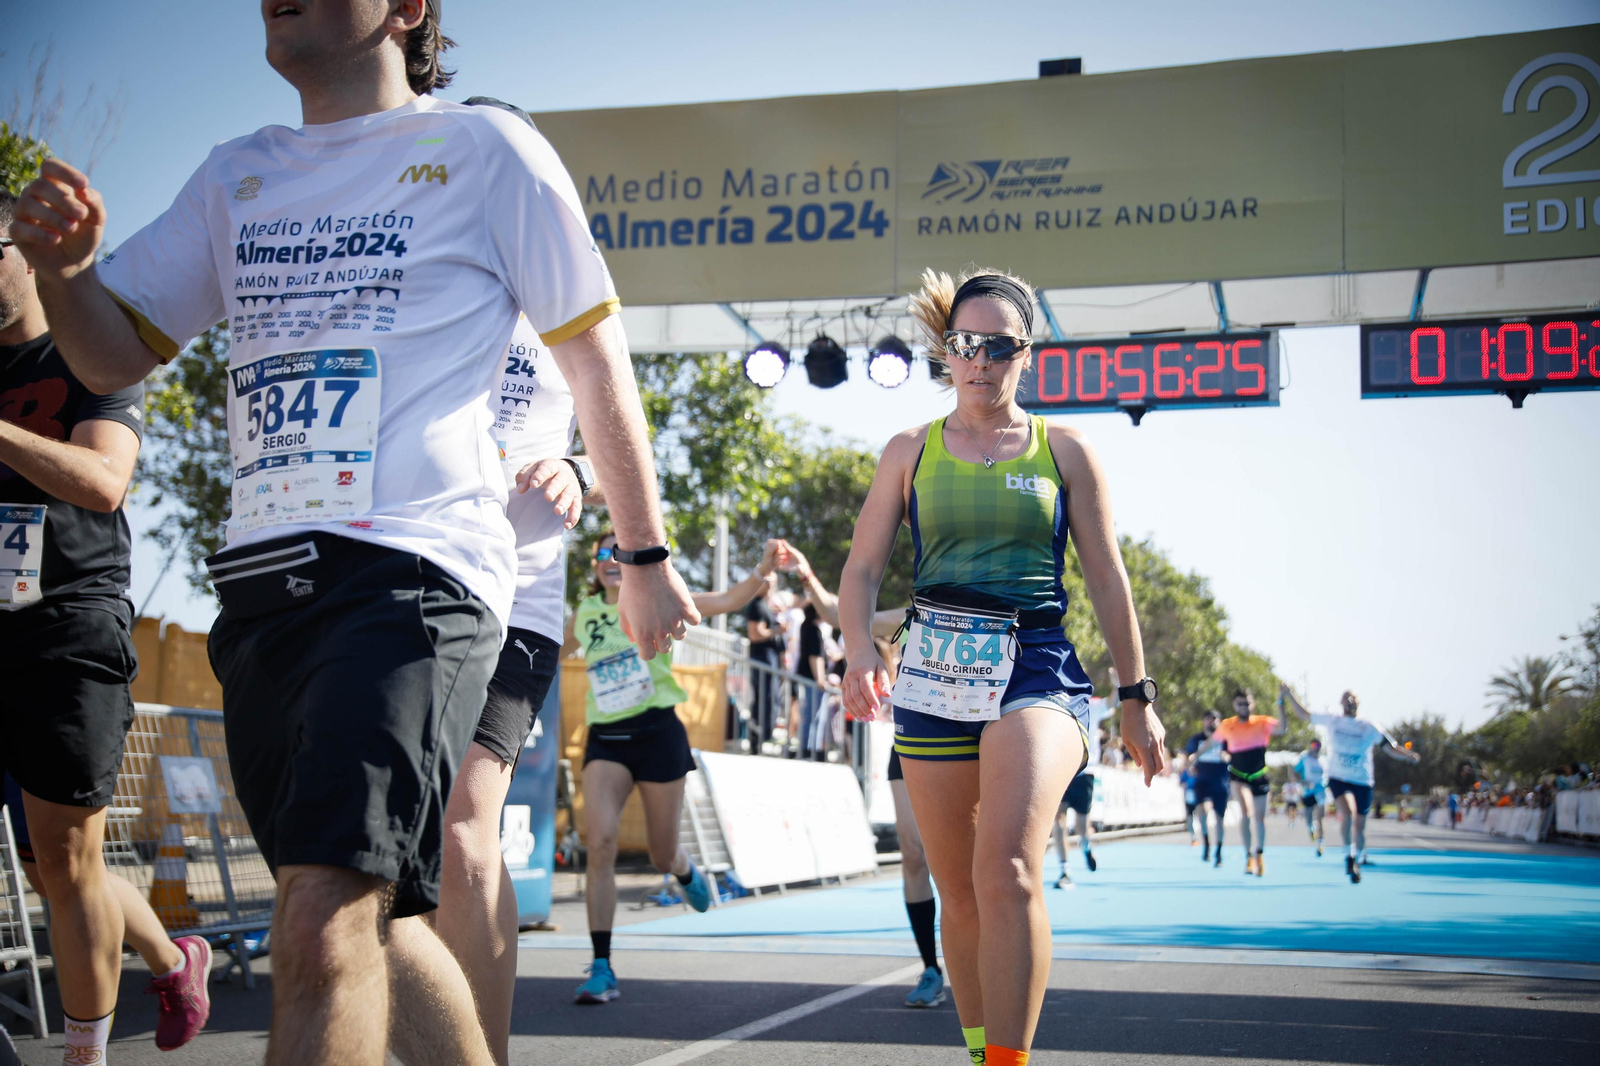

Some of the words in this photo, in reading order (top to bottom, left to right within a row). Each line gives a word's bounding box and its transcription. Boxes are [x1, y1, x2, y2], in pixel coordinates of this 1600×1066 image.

[586, 169, 703, 205] Medio
[721, 160, 890, 199] Maratón
[996, 173, 1063, 188] SERIES
[240, 217, 302, 242] Medio
[311, 209, 414, 235] Maratón
[588, 206, 754, 251] Almería
[765, 199, 890, 244] 2024
[917, 208, 1022, 237] RAMÓN
[1035, 207, 1102, 231] RUIZ
[1114, 196, 1259, 227] ANDÚJAR
[1502, 196, 1600, 236] EDI
[236, 237, 328, 268] Almería
[328, 231, 408, 258] 2024
[235, 272, 279, 290] AMÓN
[286, 272, 320, 289] RUIZ
[324, 264, 404, 284] ANDÚJAR
[329, 312, 348, 320] 2013
[352, 303, 371, 311] 2005
[376, 304, 396, 315] 2006
[332, 322, 361, 330] 2022/23
[263, 364, 291, 379] Almería
[291, 361, 317, 373] 2024
[1037, 339, 1266, 403] 00:56:25
[247, 379, 361, 442] 5847
[262, 432, 307, 450] SERGIO
[1005, 472, 1050, 495] bida
[934, 618, 956, 628] Almería
[956, 621, 974, 629] 2024
[918, 626, 1004, 667] 5764
[594, 655, 643, 684] 5624
[921, 659, 950, 672] ABUELO
[952, 665, 993, 675] CIRINEO
